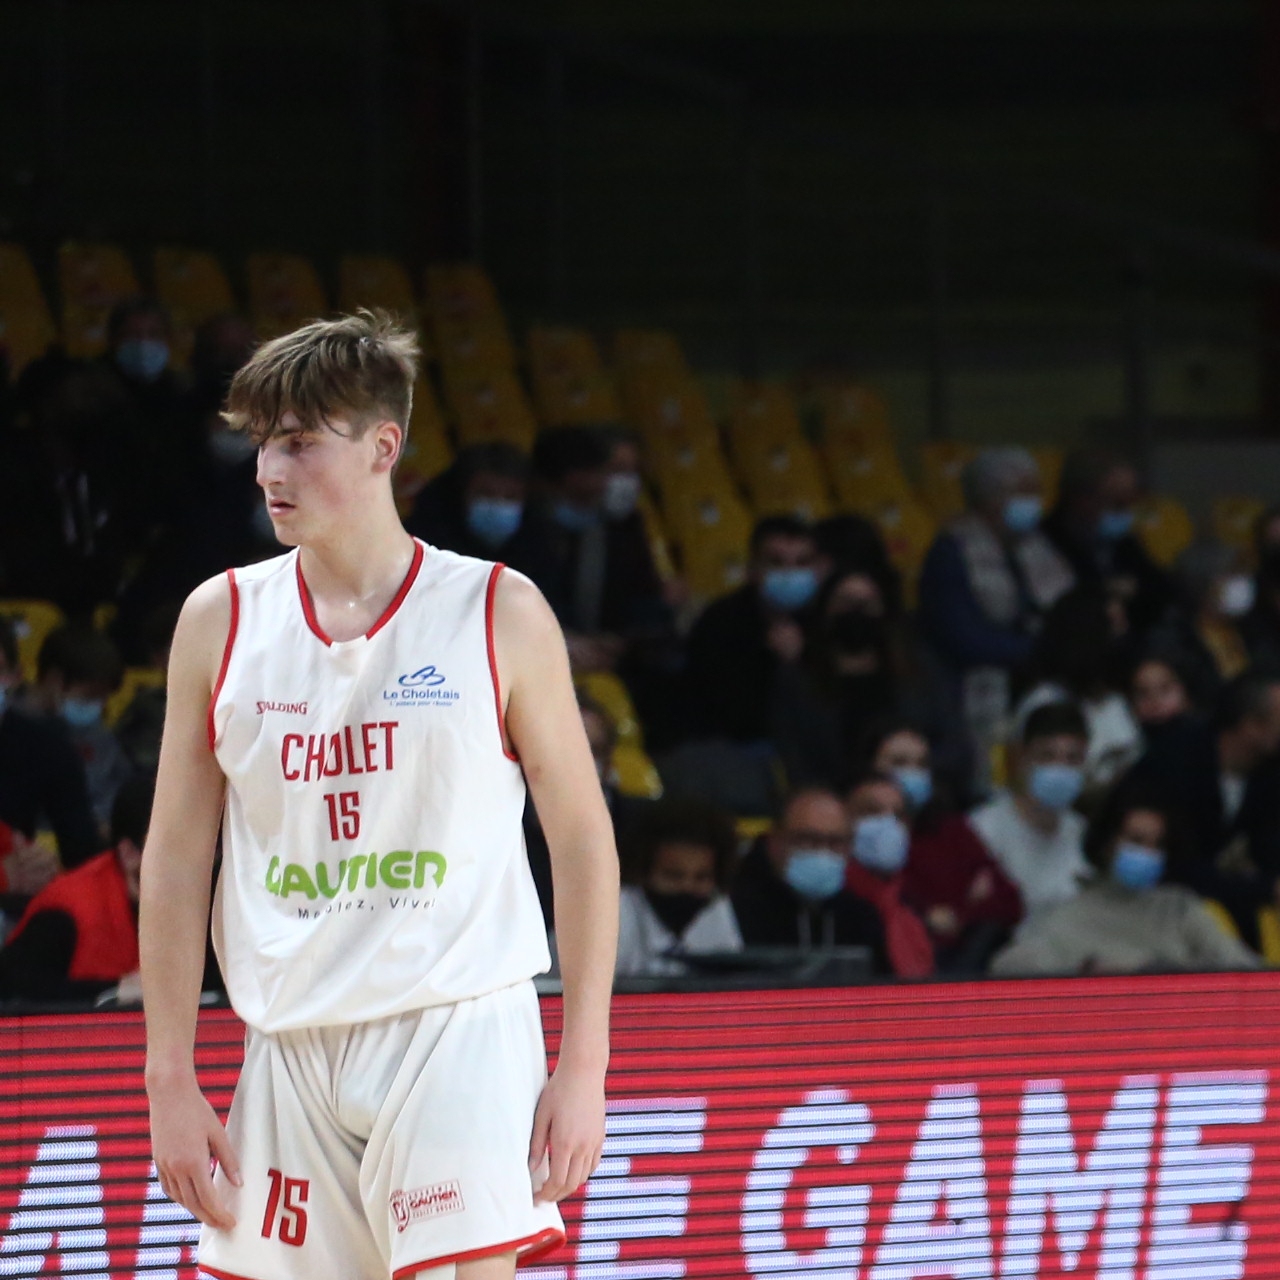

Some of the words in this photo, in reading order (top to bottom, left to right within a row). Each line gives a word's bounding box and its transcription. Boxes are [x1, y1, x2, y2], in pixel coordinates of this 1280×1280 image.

[256, 701, 308, 715] SPALDING
[383, 689, 398, 700] Le
[401, 687, 460, 700] Choletais
[281, 721, 399, 782] CHOLET
[323, 791, 361, 841] 15
[265, 851, 447, 900] GAUTIER
[262, 1167, 309, 1246] 15
